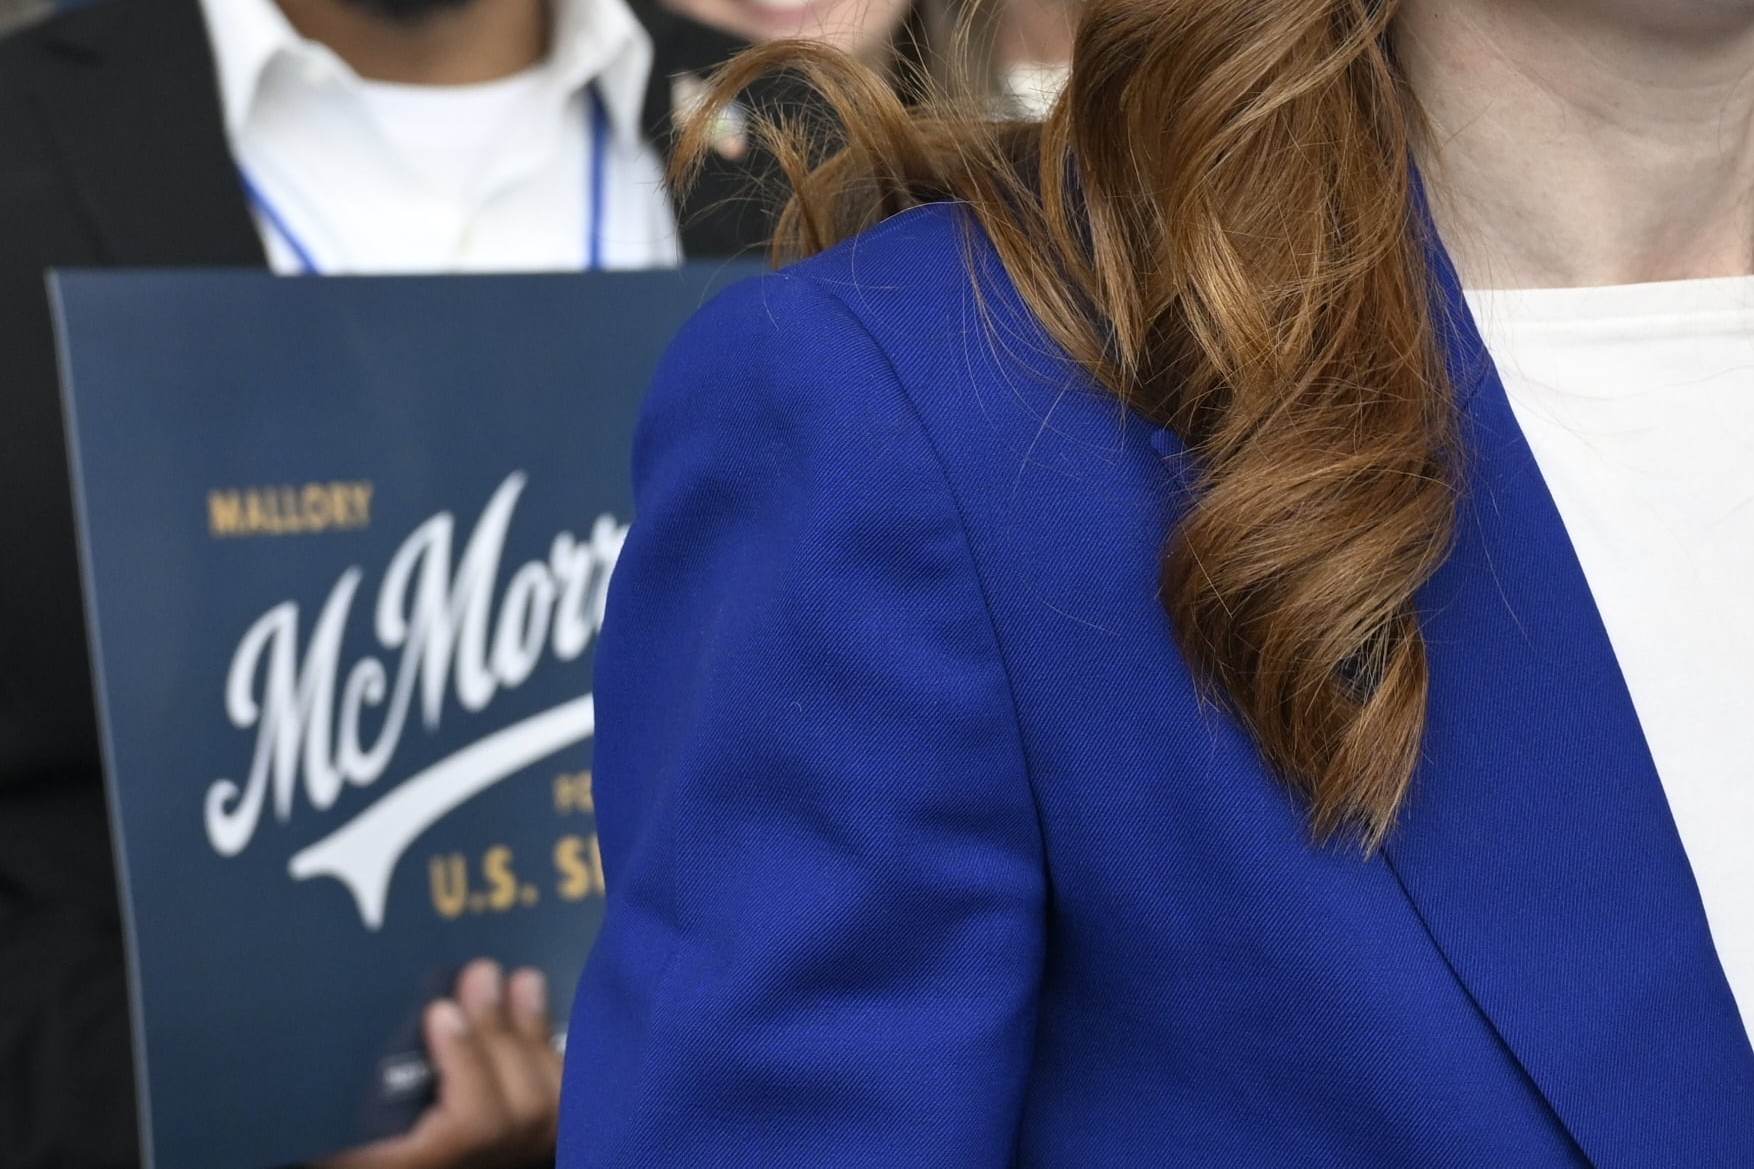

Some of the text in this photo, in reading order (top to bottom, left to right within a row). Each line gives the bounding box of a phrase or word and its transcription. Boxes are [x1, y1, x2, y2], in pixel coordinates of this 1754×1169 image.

[210, 482, 372, 536] MALLORY
[205, 470, 632, 856] McMorr
[555, 771, 594, 813] FO
[430, 843, 539, 918] U.S.
